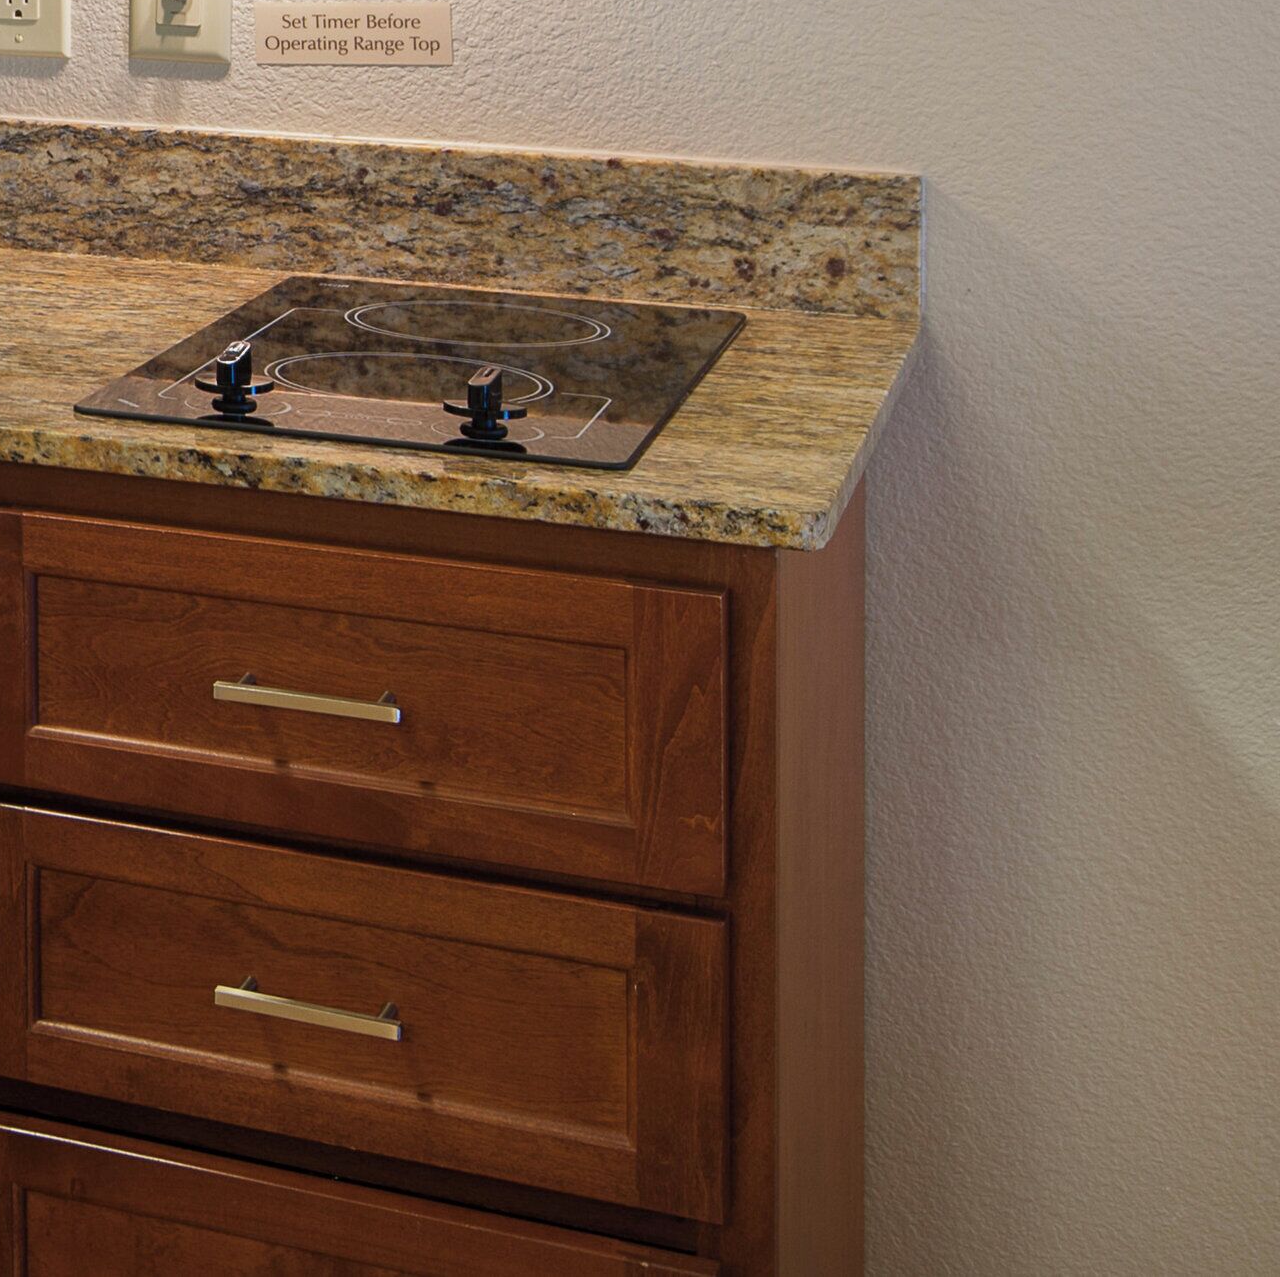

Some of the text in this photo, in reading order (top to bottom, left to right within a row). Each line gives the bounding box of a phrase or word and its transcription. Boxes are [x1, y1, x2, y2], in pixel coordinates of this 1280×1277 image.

[281, 13, 421, 29] Set Timer Before
[264, 35, 441, 56] Operating Range Top
